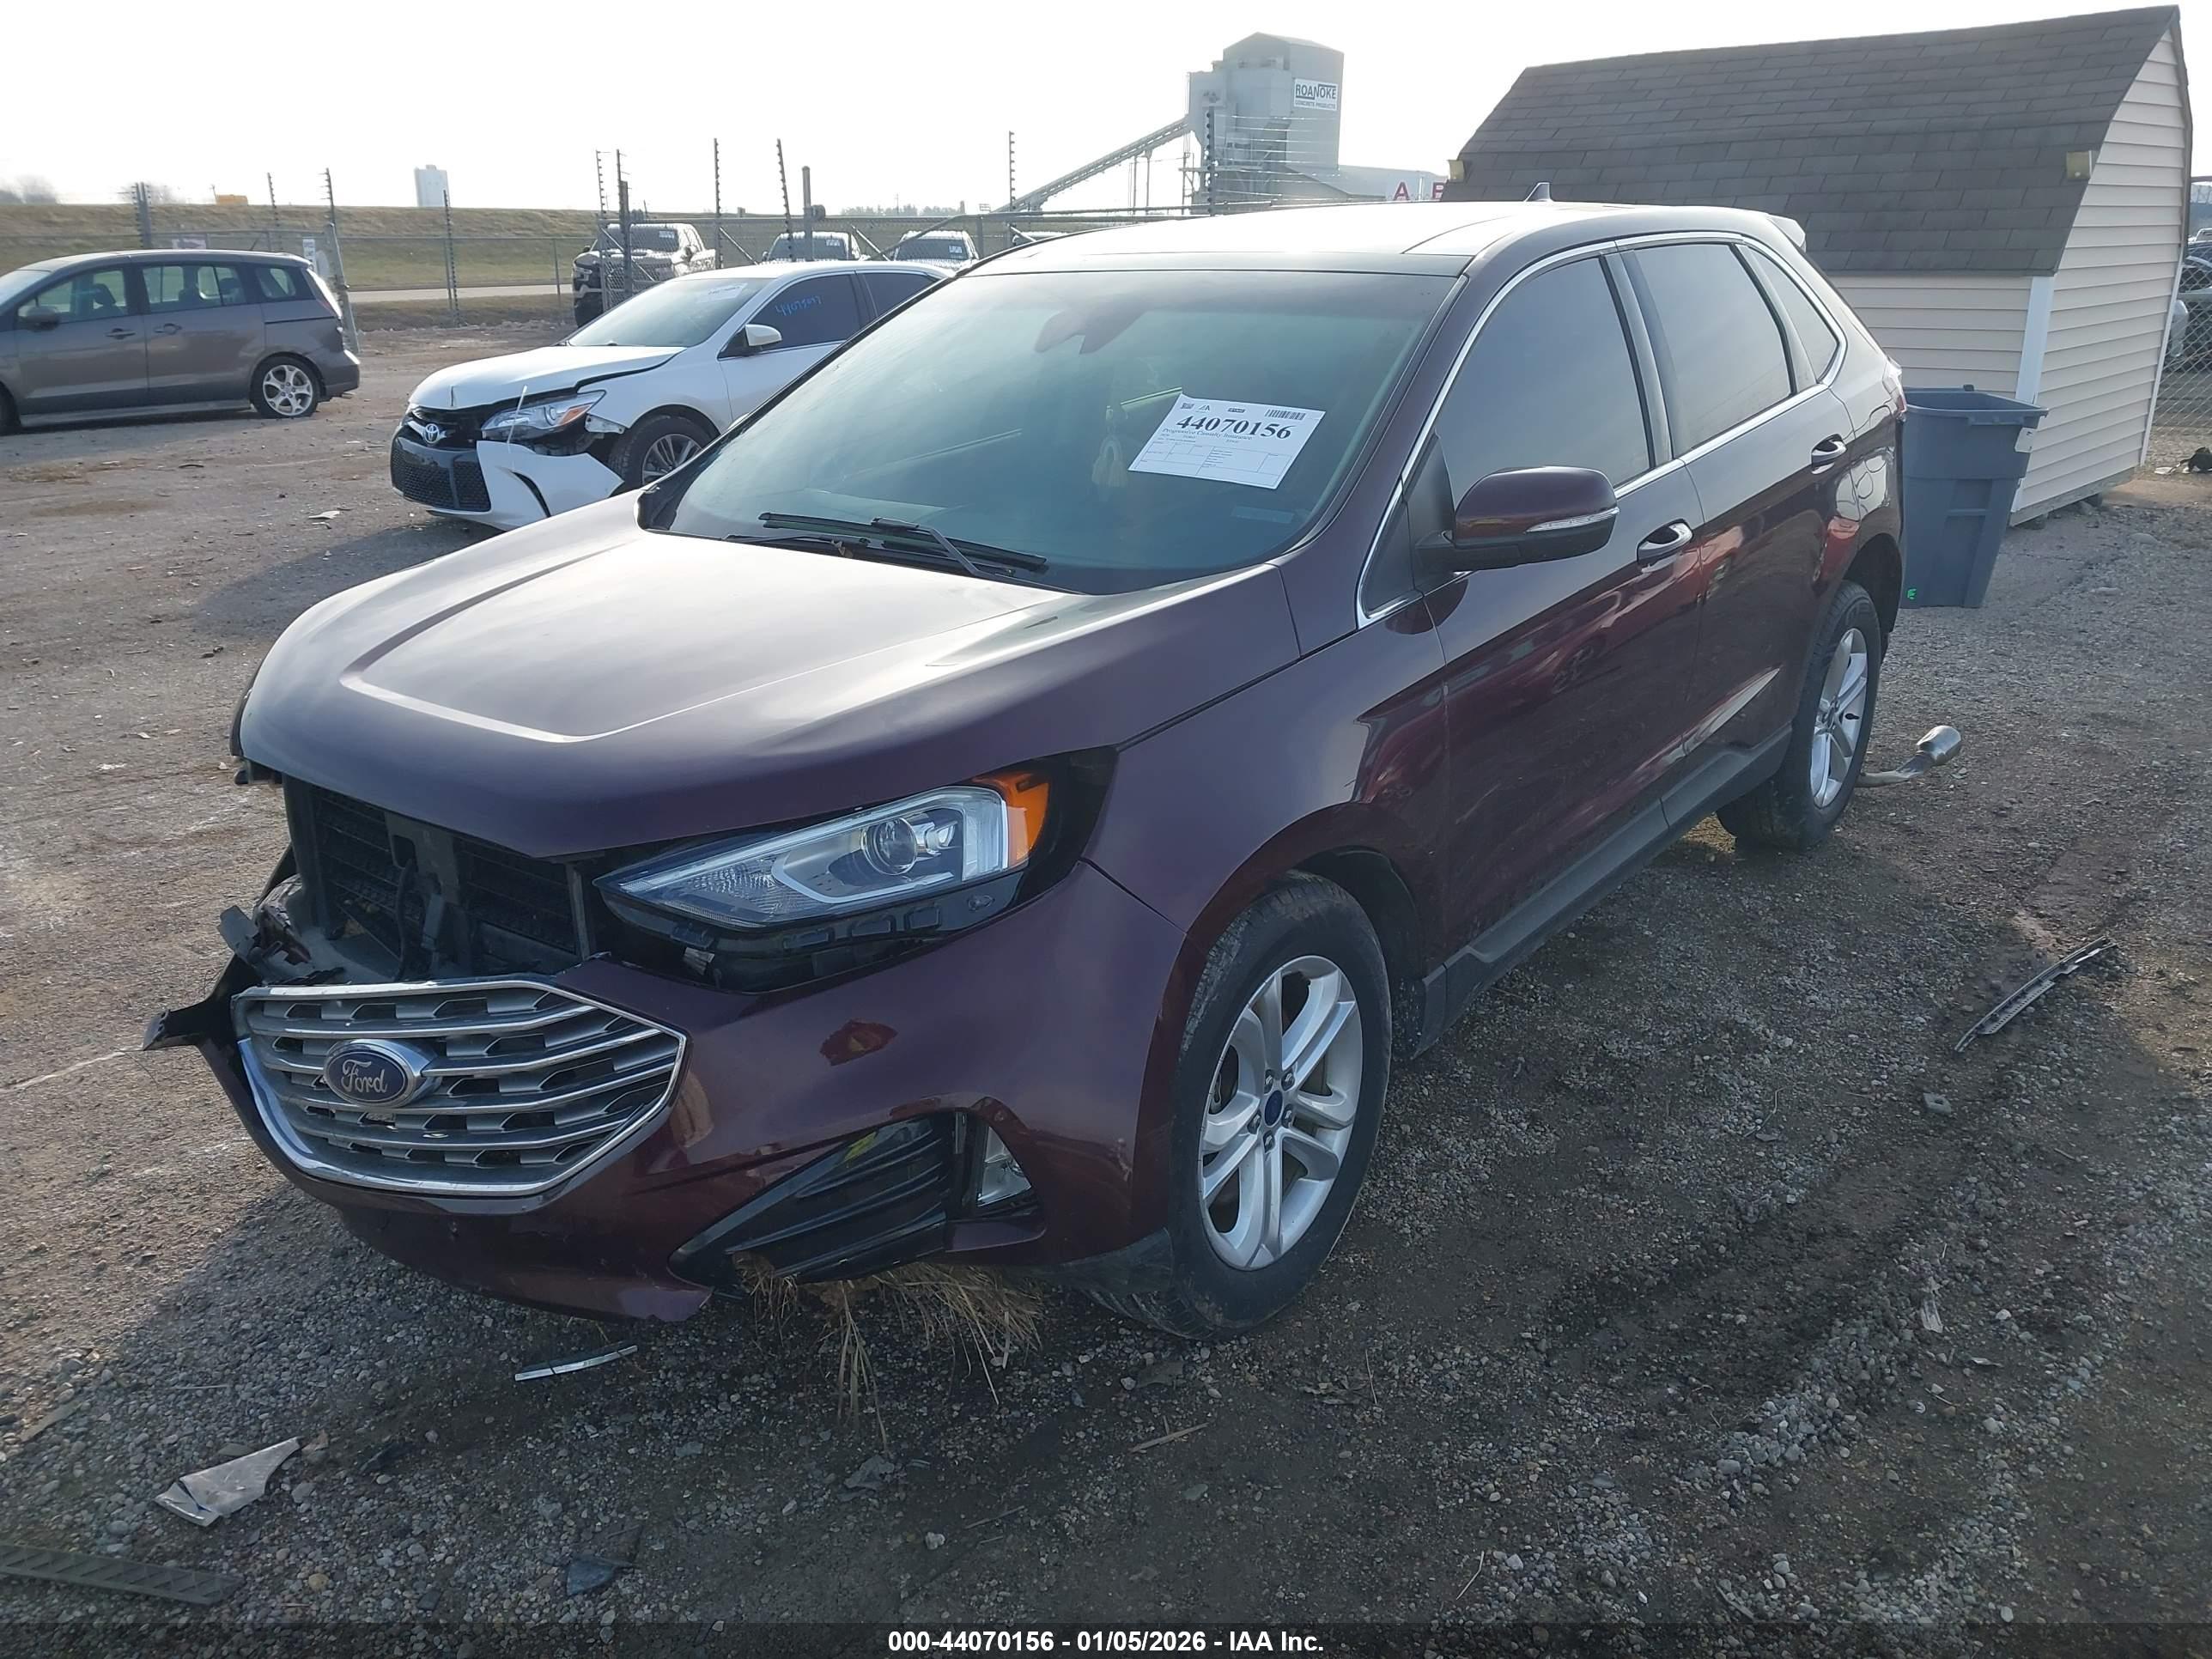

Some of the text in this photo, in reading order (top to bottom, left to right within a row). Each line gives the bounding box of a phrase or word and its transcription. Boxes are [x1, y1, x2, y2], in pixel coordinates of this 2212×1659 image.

[1295, 83, 1337, 100] ROANOKE
[1176, 415, 1296, 440] 44070156
[341, 1059, 387, 1093] Ford
